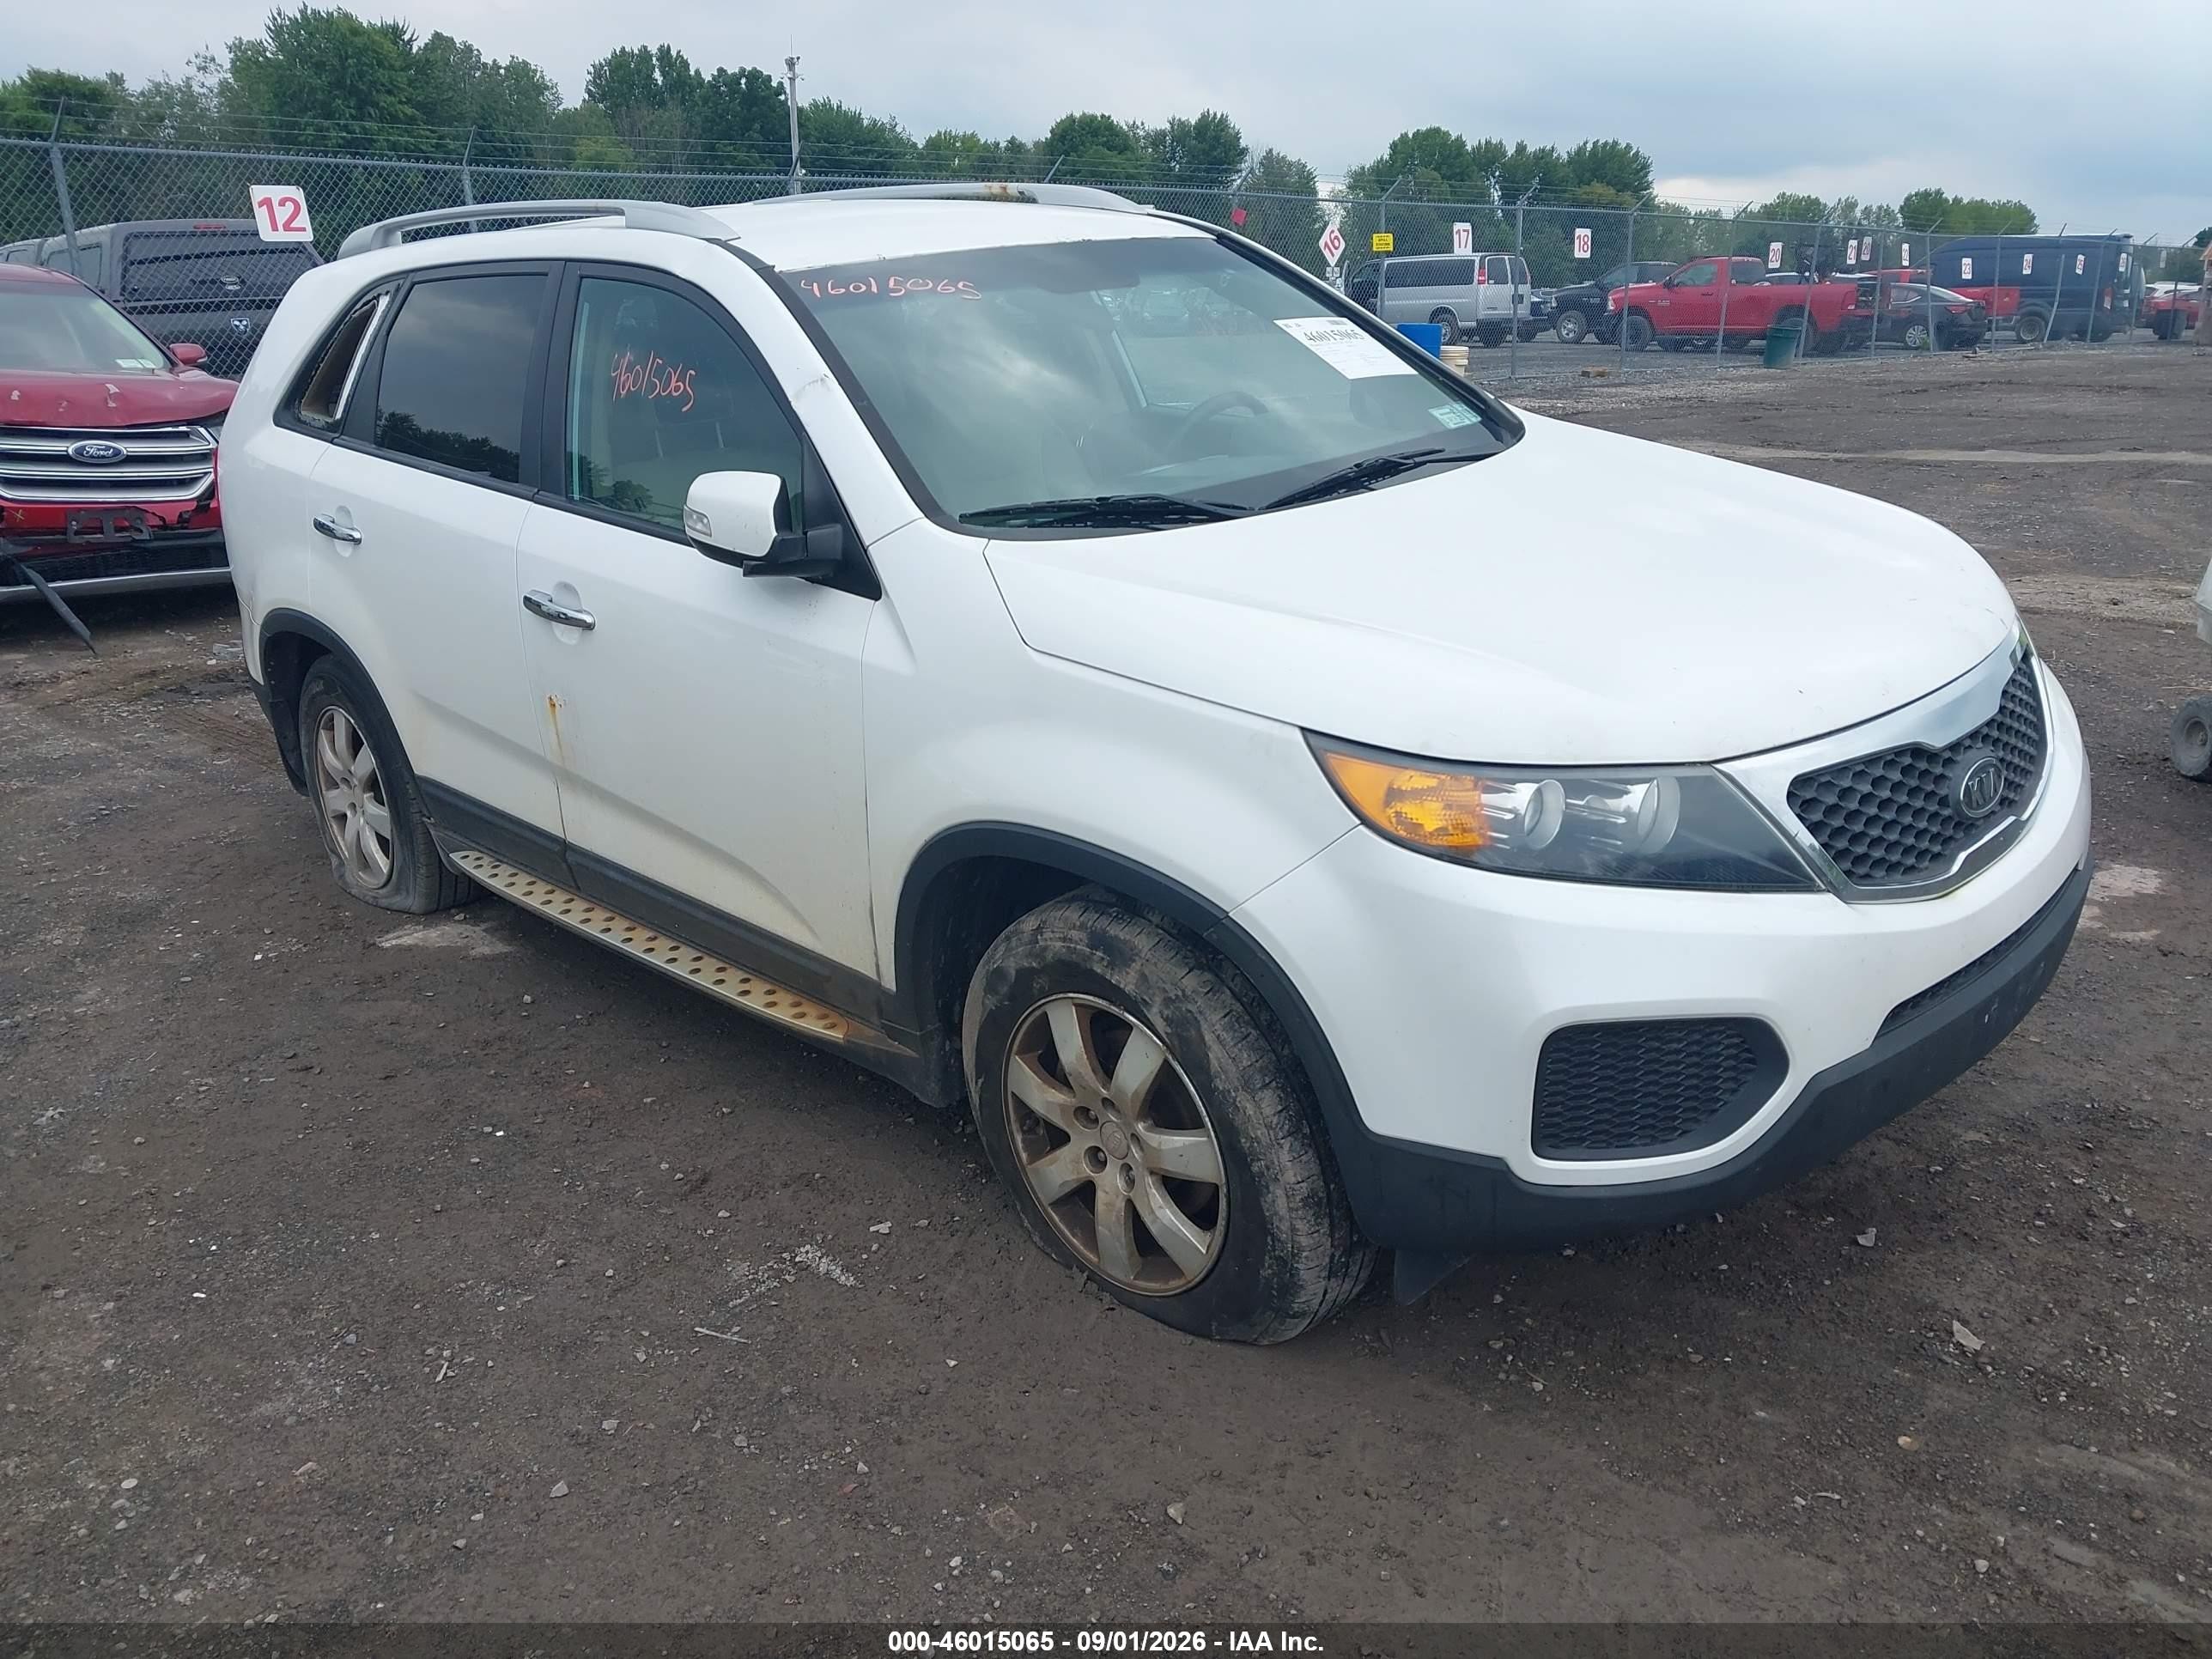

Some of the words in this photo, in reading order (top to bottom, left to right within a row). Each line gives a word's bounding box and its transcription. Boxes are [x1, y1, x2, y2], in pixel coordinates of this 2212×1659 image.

[258, 197, 307, 232] 12
[1324, 228, 1341, 258] 16
[1455, 228, 1470, 249] 17
[1576, 234, 1589, 253] 18
[1770, 247, 1781, 263] 20
[1848, 244, 1856, 261] 21
[1962, 263, 1971, 275] 23
[2023, 258, 2031, 270] 24
[800, 276, 982, 299] 46015065
[1303, 329, 1365, 343] 46015065
[611, 351, 696, 412] 46015065
[83, 445, 113, 457] Ford
